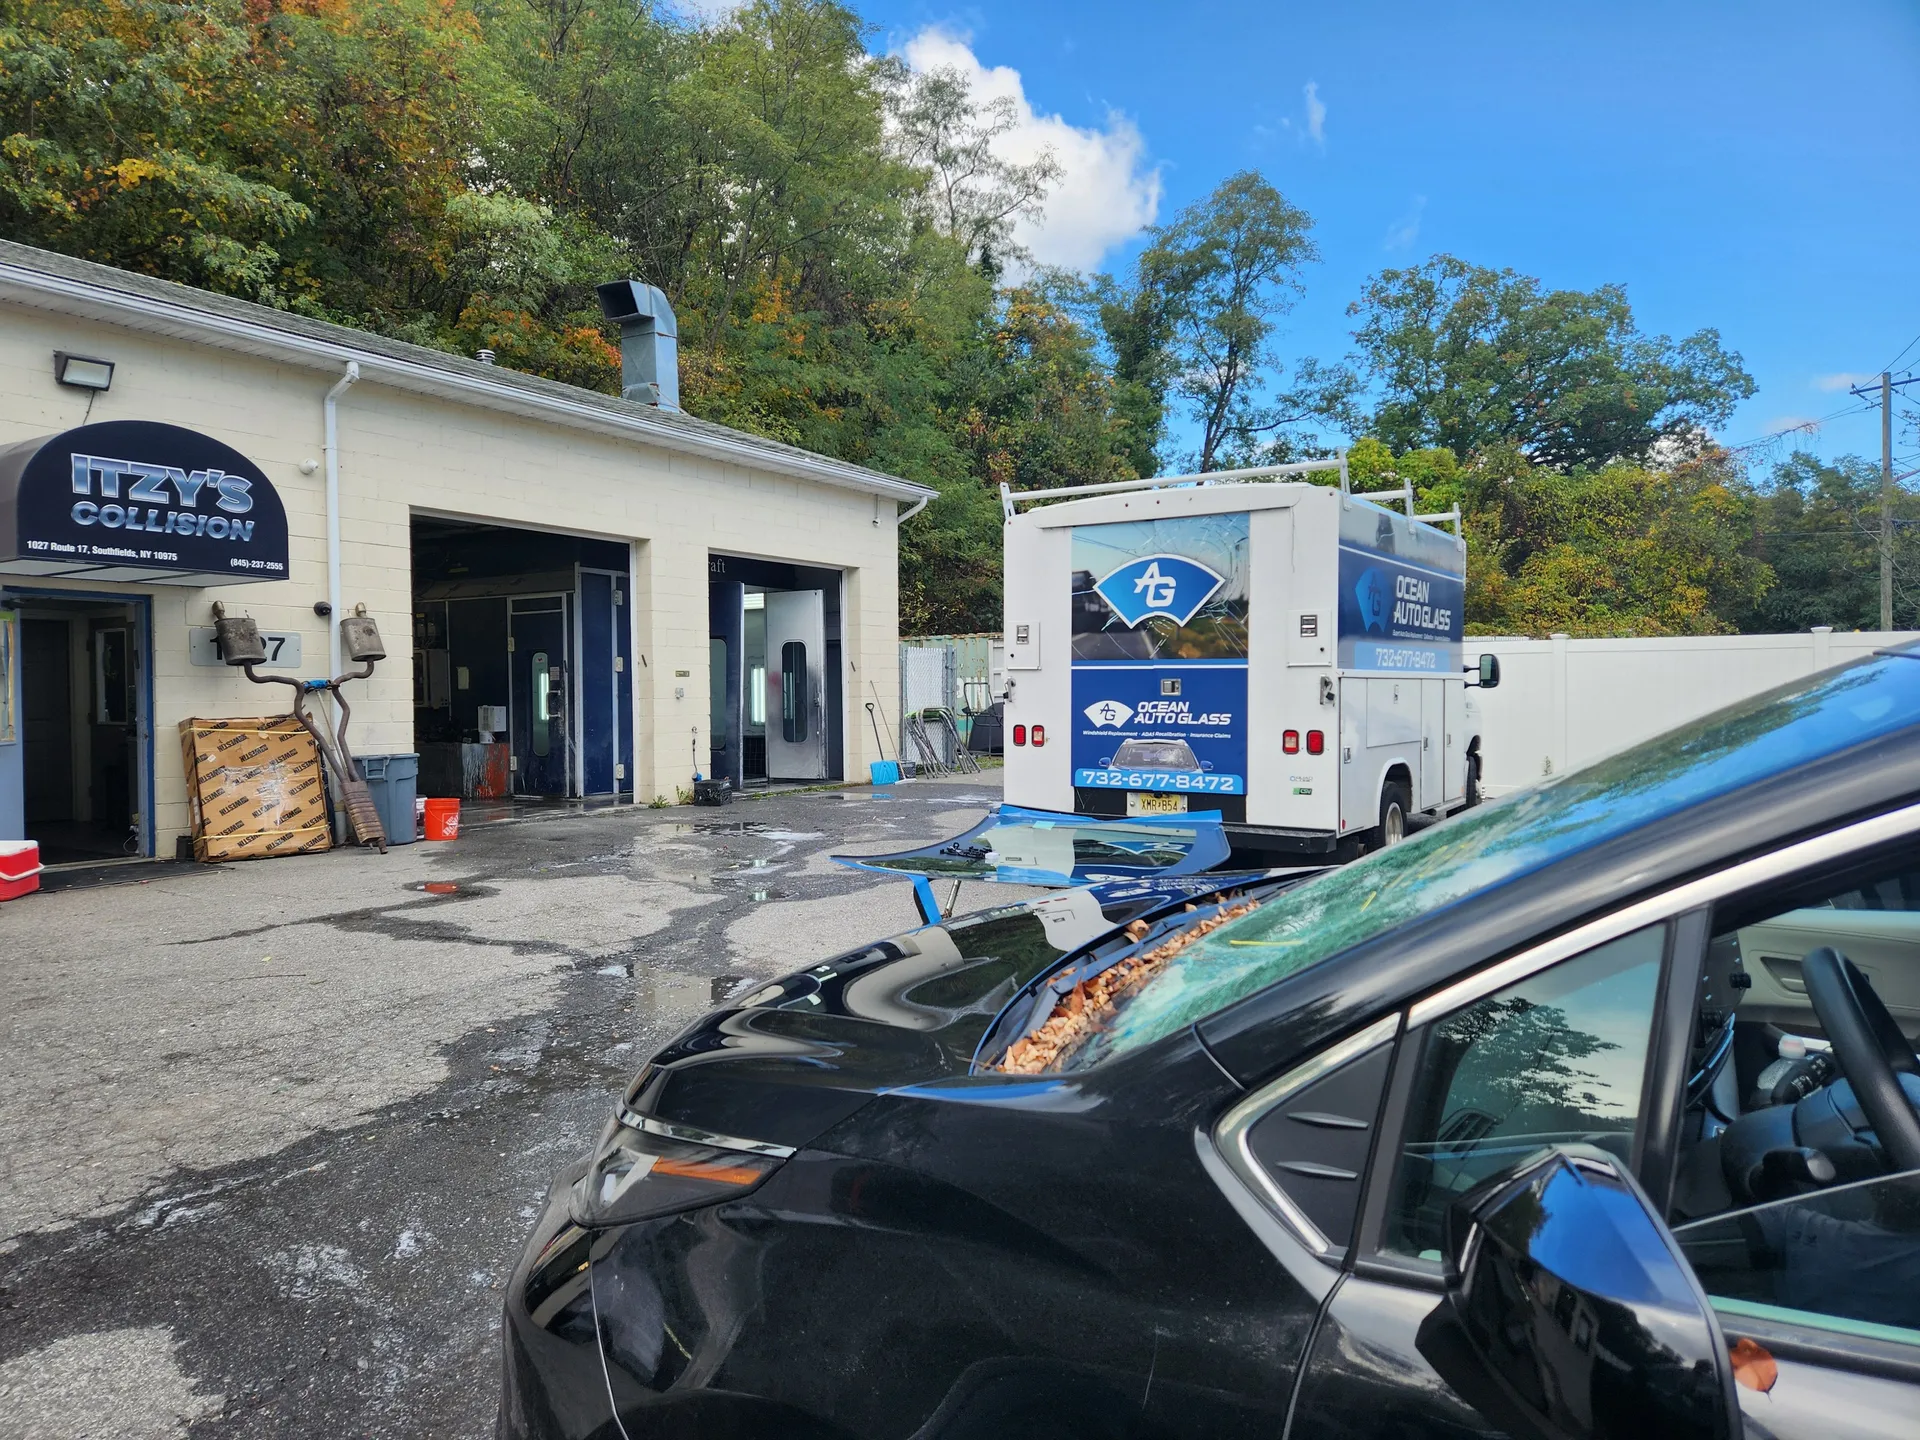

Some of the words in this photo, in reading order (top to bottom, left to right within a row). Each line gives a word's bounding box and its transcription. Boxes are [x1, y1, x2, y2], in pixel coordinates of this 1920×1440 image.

[71, 453, 253, 513] ITZY'S
[71, 501, 255, 541] COLLISION
[26, 540, 49, 550] 1027
[50, 542, 75, 552] Route
[76, 545, 91, 554] 17,
[92, 546, 138, 558] Southfields,
[140, 550, 152, 558] NY
[154, 551, 178, 561] 10975
[230, 558, 283, 570] (845)-237-2555
[1133, 561, 1177, 608] AG
[1396, 575, 1430, 604] OCEAN
[1393, 600, 1421, 627] AUTO
[1421, 605, 1452, 631] GLASS
[1375, 647, 1436, 669] 732-677-8472
[1100, 703, 1117, 721] AG
[1137, 701, 1189, 713] OCEAN
[1134, 712, 1176, 724] AUTO
[1177, 713, 1232, 725] GLASS
[1082, 770, 1234, 791] 732-677-8472
